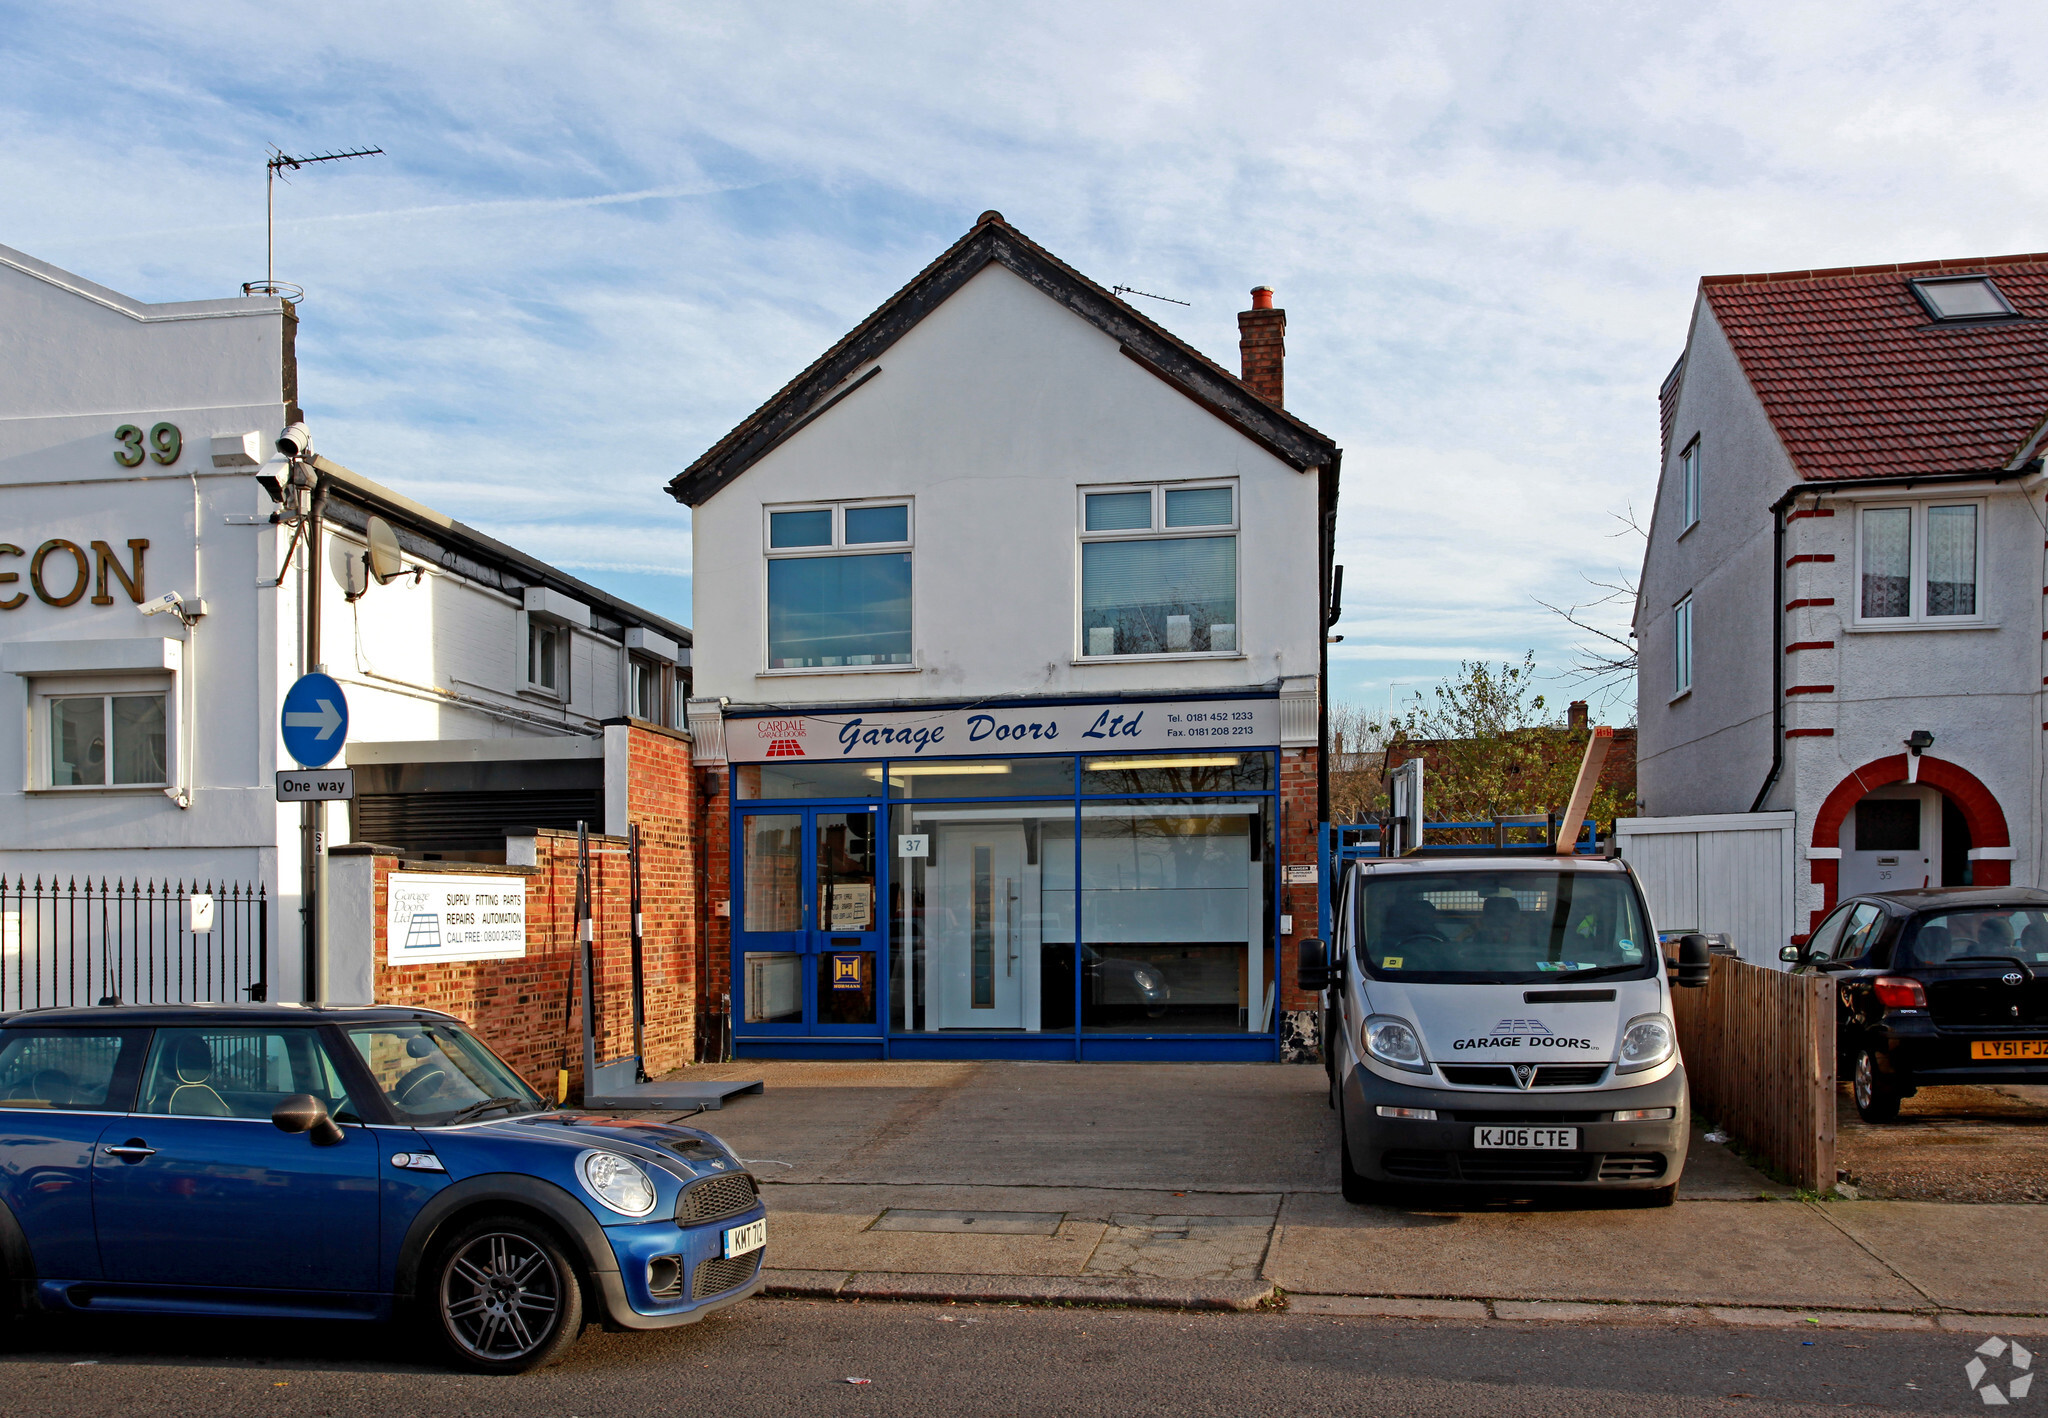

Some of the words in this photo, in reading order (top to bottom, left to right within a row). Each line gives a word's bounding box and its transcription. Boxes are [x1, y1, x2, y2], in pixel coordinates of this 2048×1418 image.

[113, 421, 183, 468] 39
[1167, 714, 1183, 723] Tel.
[1186, 713, 1207, 722] 0181
[1210, 712, 1228, 721] 452
[1231, 711, 1254, 720] 1233
[757, 719, 807, 733] CARDALE
[838, 717, 945, 755] Garage
[966, 714, 1060, 742] Doors
[1081, 709, 1144, 739] Ltd
[1167, 728, 1186, 737] Fax.
[1188, 728, 1209, 737] 0181
[1211, 727, 1230, 736] 208
[1231, 726, 1254, 735] 2213
[758, 731, 784, 739] GARAGE
[784, 730, 807, 738] DOORS
[283, 779, 311, 793] One
[317, 781, 345, 794] way
[905, 840, 921, 852] 37
[1879, 870, 1892, 880] 35
[394, 888, 430, 902] Garage
[446, 893, 471, 906] SUPPLY
[475, 894, 499, 906] FITTING
[503, 894, 522, 906] PARTS
[394, 900, 425, 912] Doors
[394, 911, 411, 923] Ltd
[446, 913, 475, 925] REPAIRS
[482, 912, 522, 924] AUTOMATION
[446, 932, 463, 943] CALL
[464, 931, 483, 943] FREE:
[484, 931, 500, 942] 0800
[501, 930, 522, 941] 243759
[841, 963, 853, 975] H
[1452, 1036, 1522, 1050] GARAGE
[1529, 1037, 1591, 1049] DOORS
[1981, 1042, 2018, 1057] LY51
[1480, 1129, 1528, 1147] KJ06
[1533, 1130, 1569, 1147] CTE
